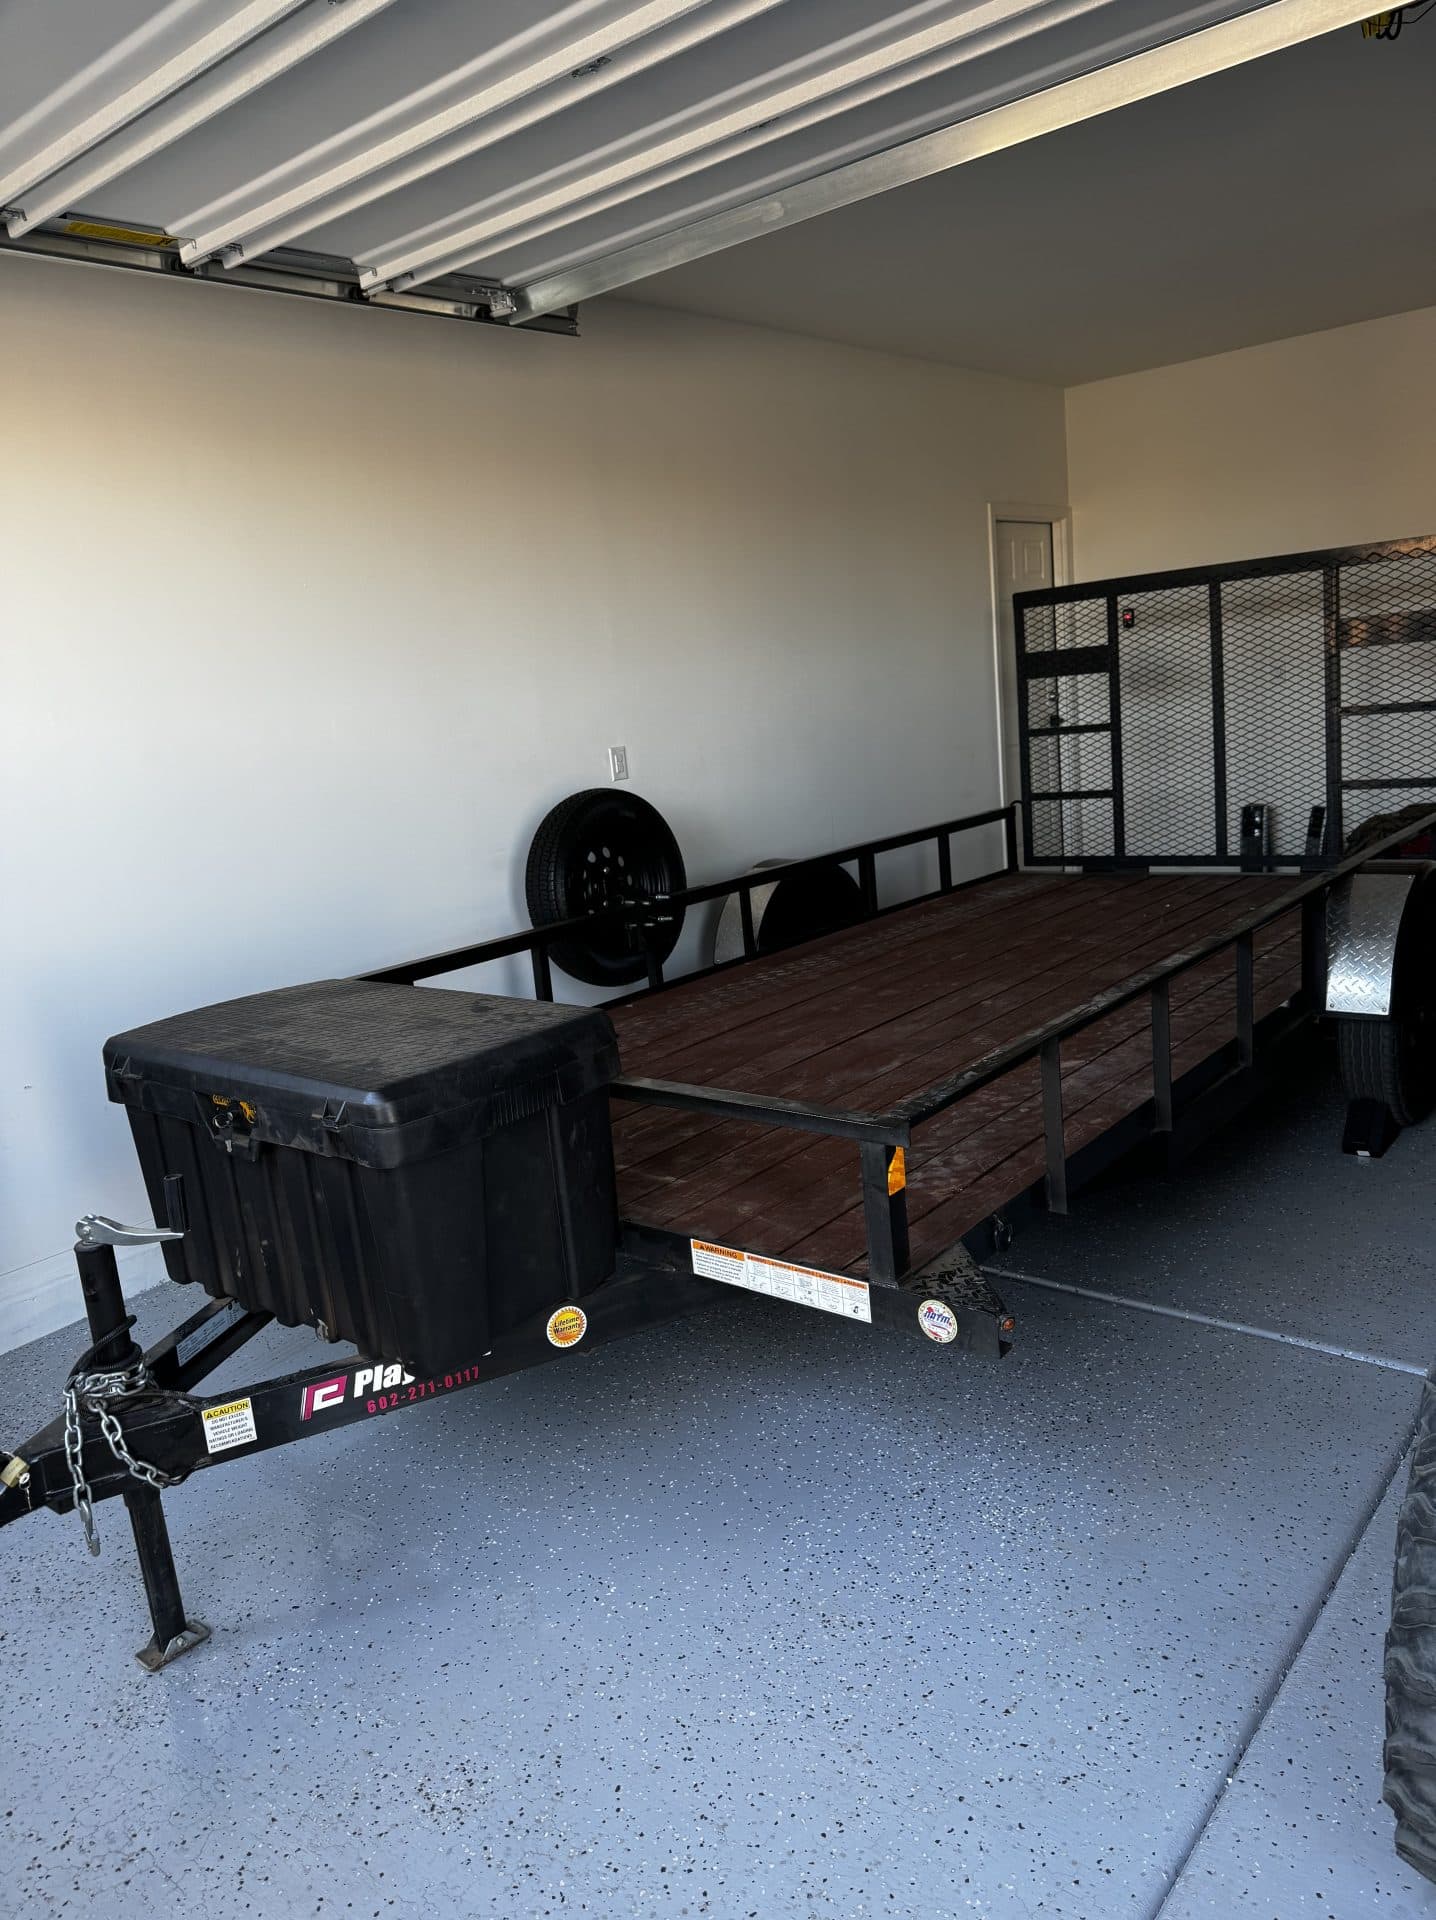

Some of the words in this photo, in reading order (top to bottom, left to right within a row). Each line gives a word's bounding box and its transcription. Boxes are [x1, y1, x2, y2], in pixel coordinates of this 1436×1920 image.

[703, 1244, 738, 1259] WARNING
[553, 1323, 581, 1334] Warranty
[554, 1317, 580, 1327] Lifetime
[367, 1366, 480, 1413] 602-271-0117
[213, 1402, 249, 1417] CAUTION
